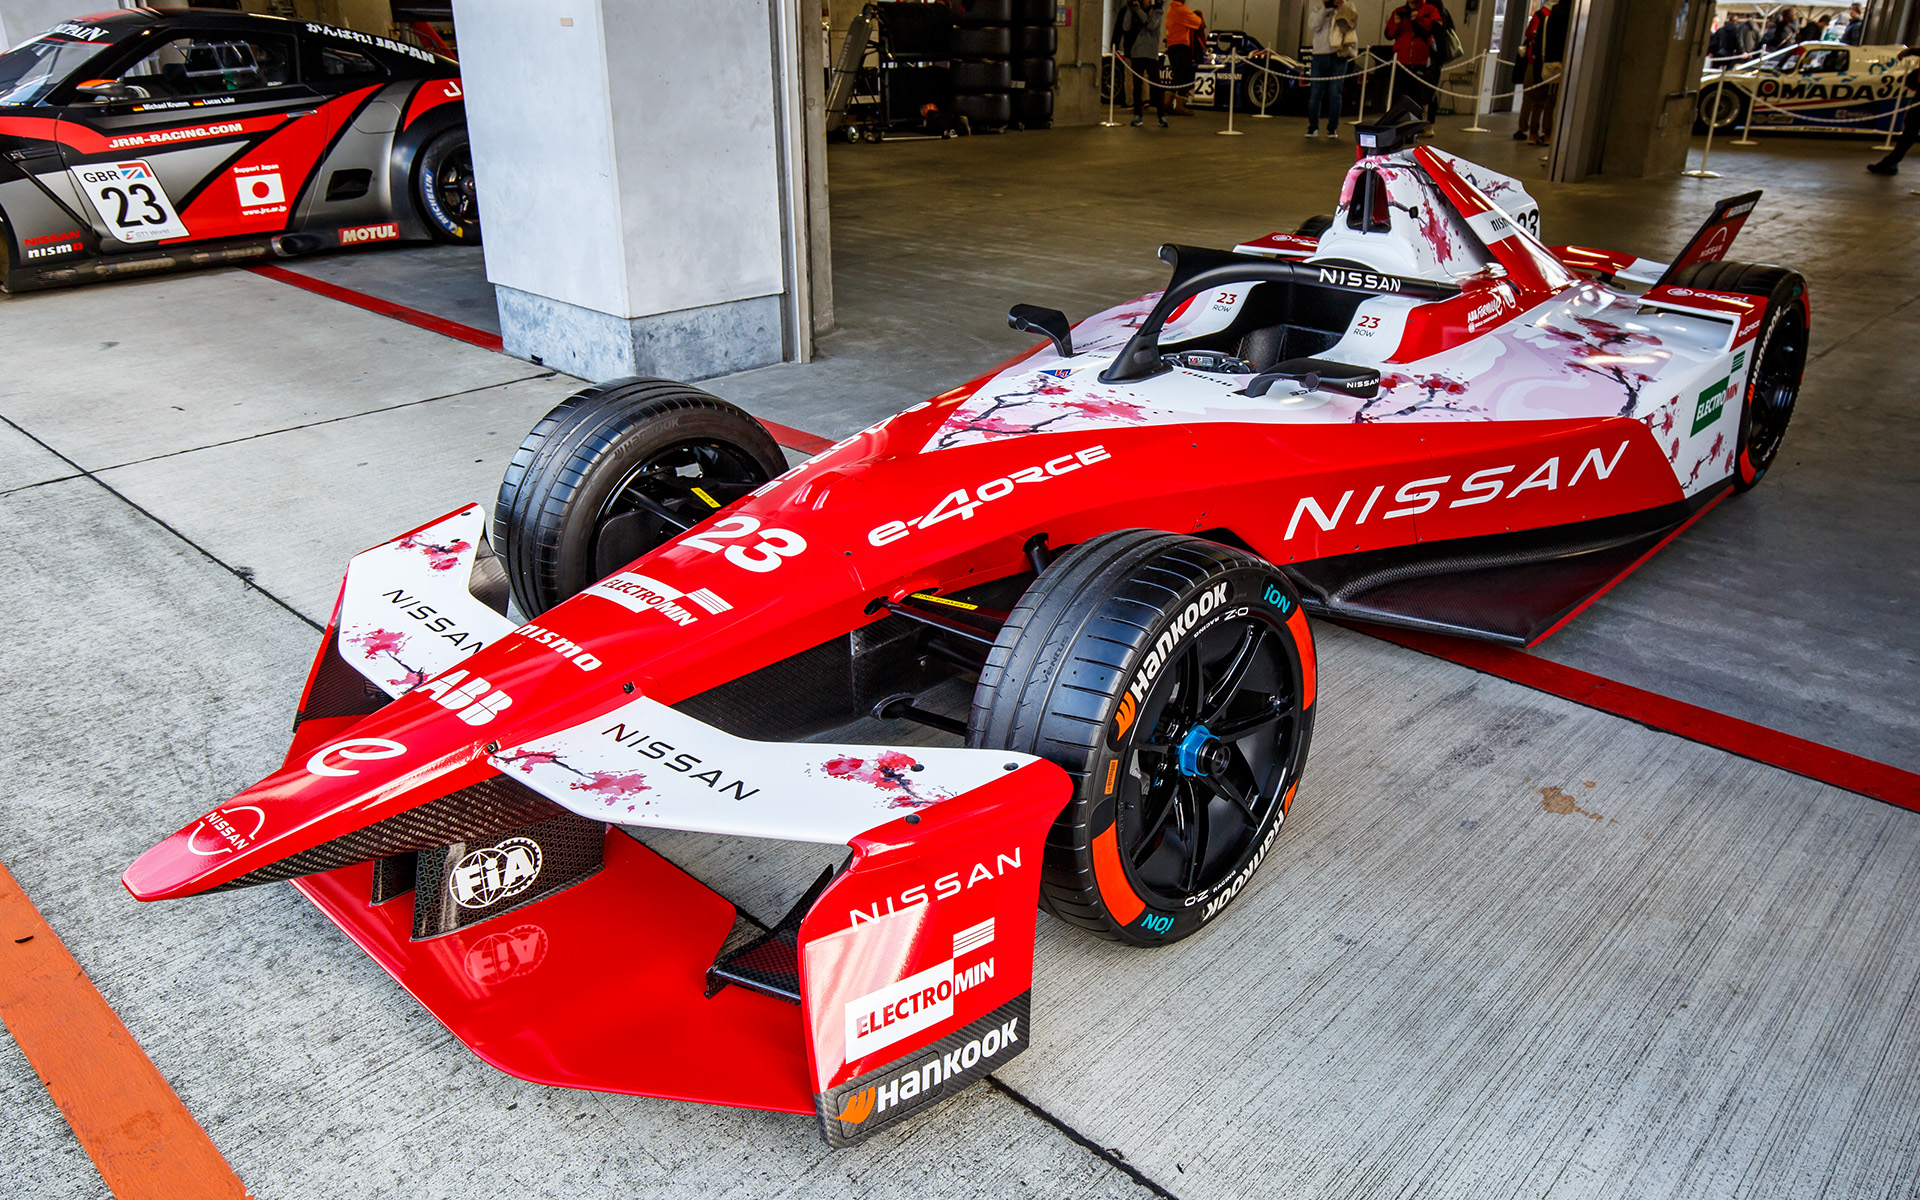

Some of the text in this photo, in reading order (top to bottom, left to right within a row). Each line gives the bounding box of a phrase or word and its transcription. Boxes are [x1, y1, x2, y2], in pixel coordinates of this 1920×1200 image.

[375, 37, 435, 64] JAPAN
[1195, 76, 1215, 95] 23
[109, 123, 243, 149] JRM-RACING.COM
[83, 170, 120, 183] GBR
[233, 165, 260, 173] Support
[101, 184, 167, 228] 23
[424, 173, 449, 225] MICHELIN
[24, 230, 80, 246] NISSAN
[343, 225, 396, 243] MOTUL
[28, 242, 83, 258] nismo
[1319, 268, 1401, 293] NISSAN
[1212, 304, 1231, 312] ROW
[1217, 292, 1237, 305] 23
[1353, 328, 1375, 338] ROW
[1357, 315, 1382, 329] 23
[1346, 378, 1379, 388] NISSAN
[1696, 381, 1740, 422] ELECTROMIN
[1284, 440, 1630, 541] NISSAN
[678, 515, 807, 573] 23
[601, 579, 698, 627] ELECTROMIN
[382, 588, 483, 655] NISSAN
[514, 624, 602, 672] nismo
[414, 669, 513, 726] ABB
[601, 723, 760, 801] NISSAN
[205, 810, 250, 850] NISSAN
[849, 847, 1022, 932] NISSAN
[856, 958, 995, 1039] ELECTROMIN
